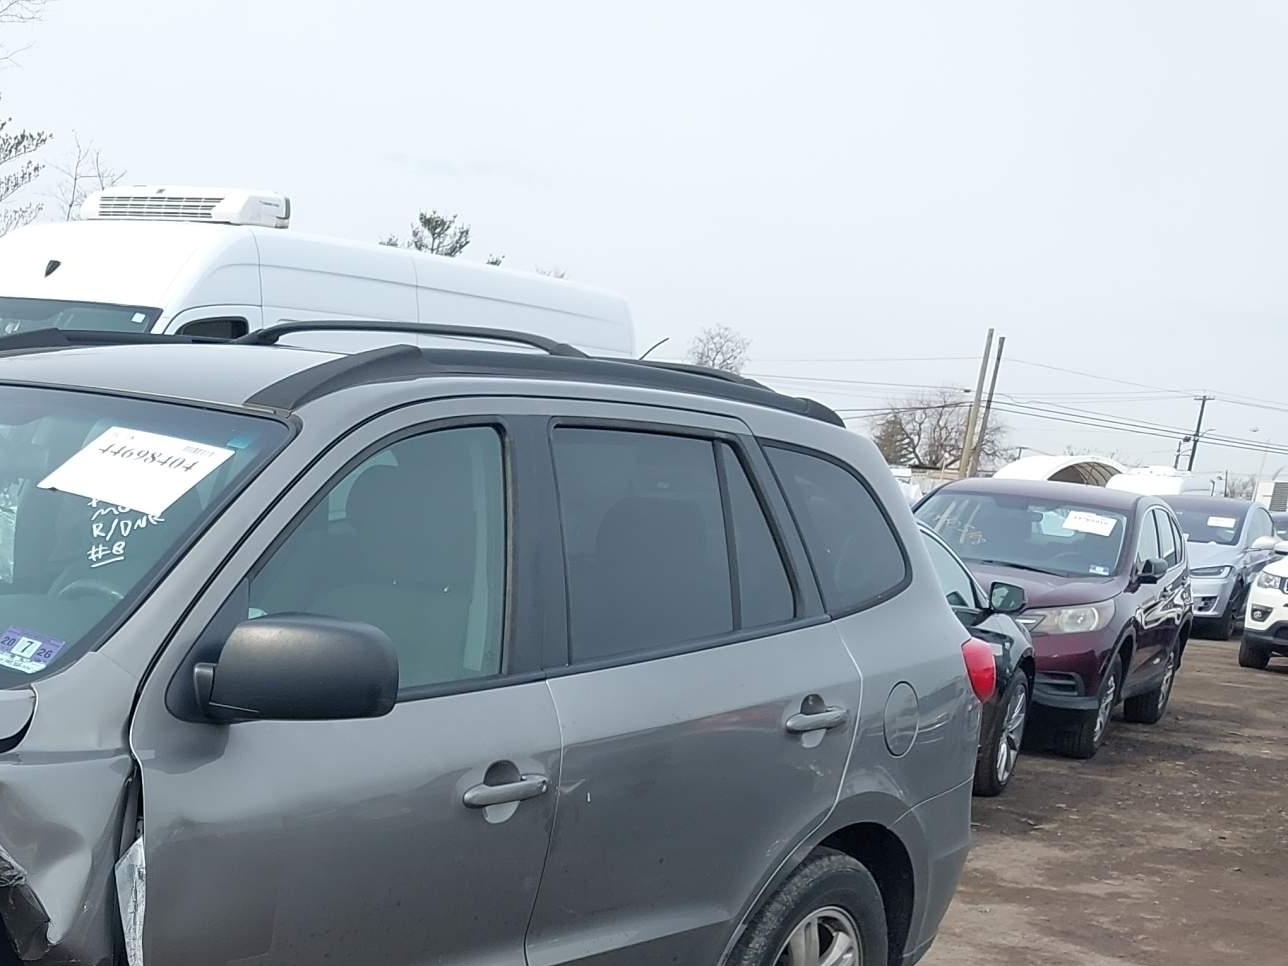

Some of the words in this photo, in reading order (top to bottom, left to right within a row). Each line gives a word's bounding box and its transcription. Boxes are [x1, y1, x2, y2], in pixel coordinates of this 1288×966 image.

[98, 443, 200, 473] 44698404
[0, 636, 17, 647] 20
[21, 640, 35, 653] 7
[37, 648, 53, 659] 26
